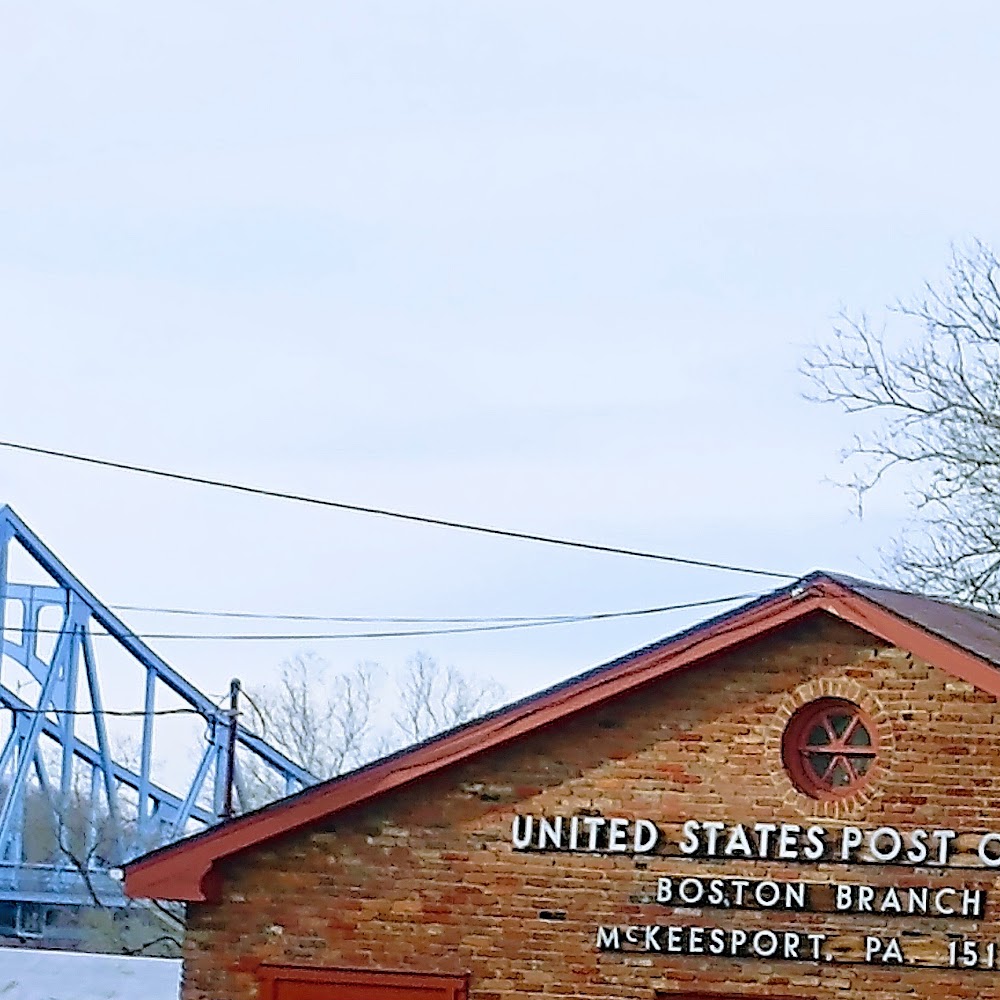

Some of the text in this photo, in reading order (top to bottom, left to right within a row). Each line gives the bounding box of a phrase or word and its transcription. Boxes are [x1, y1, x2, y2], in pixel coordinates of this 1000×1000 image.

[512, 815, 658, 852] UNITED
[679, 820, 826, 859] STATES
[841, 826, 956, 865] POST
[655, 877, 981, 916] BOSTON BRANCH
